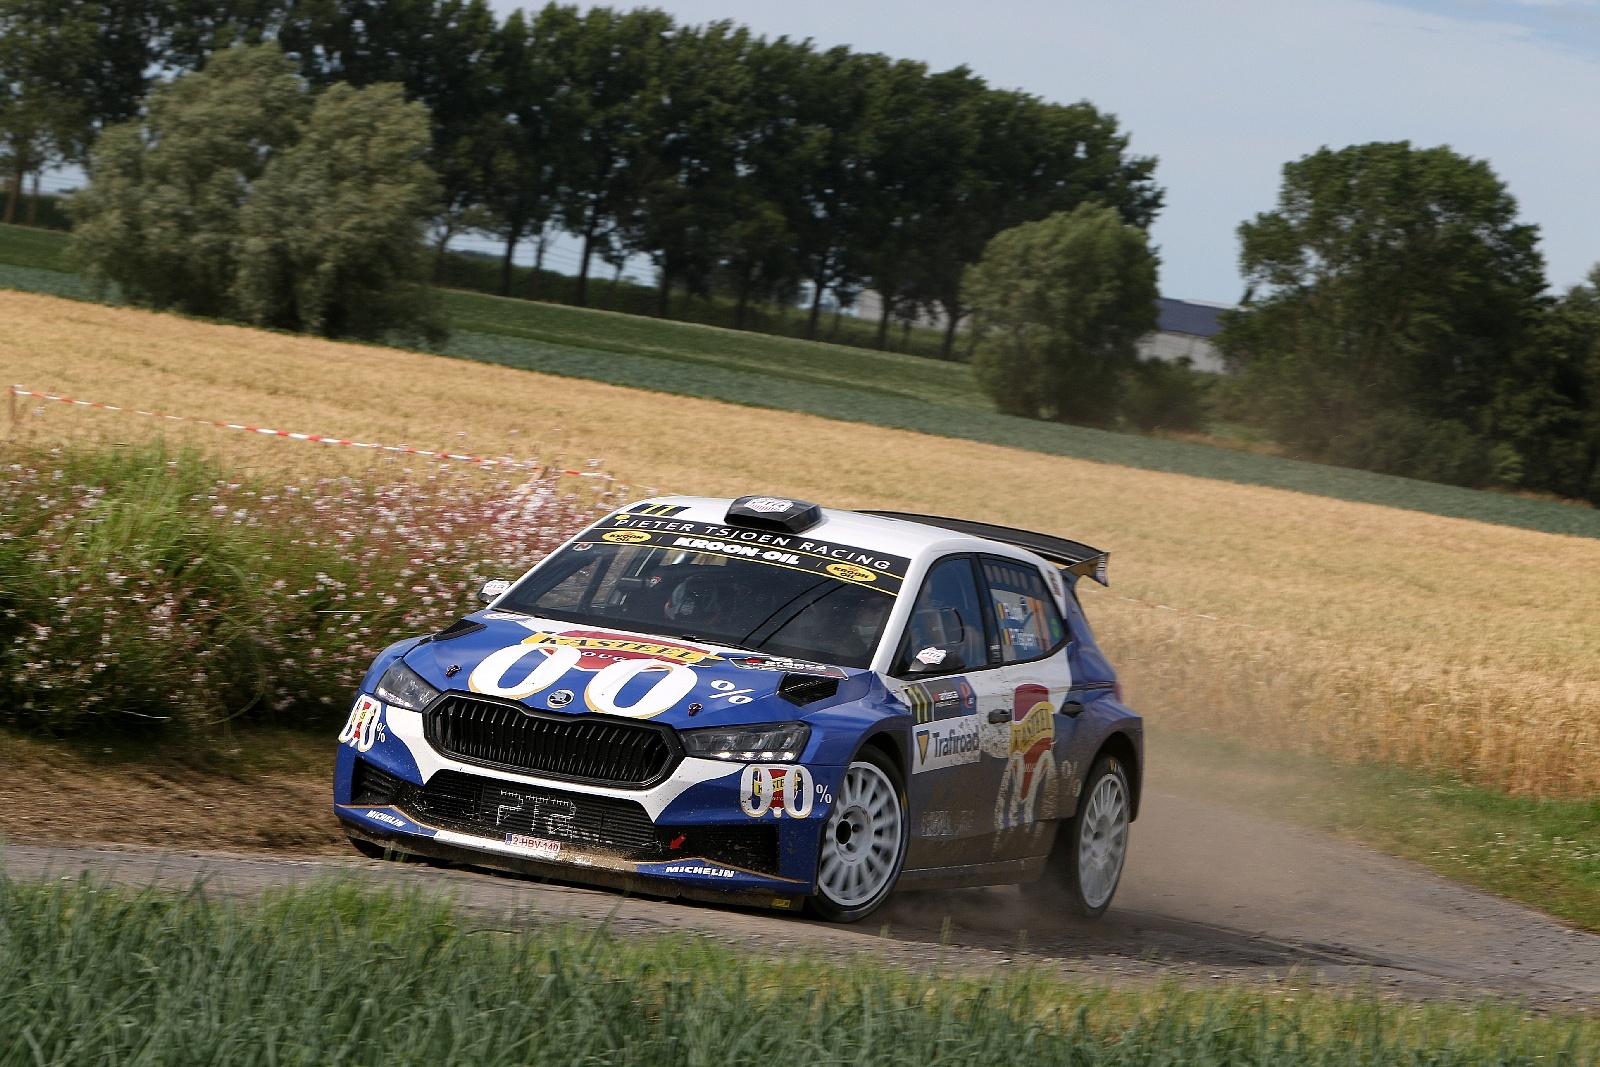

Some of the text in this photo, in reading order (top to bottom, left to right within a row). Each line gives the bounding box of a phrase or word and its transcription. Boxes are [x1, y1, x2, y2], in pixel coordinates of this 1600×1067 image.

[613, 519, 891, 570] PIETER TSJOEN RACING
[672, 536, 800, 566] KROON-OIL
[833, 566, 869, 579] KROON
[539, 636, 697, 661] KASTEEL
[932, 725, 980, 758] Trafiroad
[366, 809, 407, 827] MICHELIN
[512, 836, 560, 852] 2-HBV-140
[665, 866, 735, 878] MICHELIN
